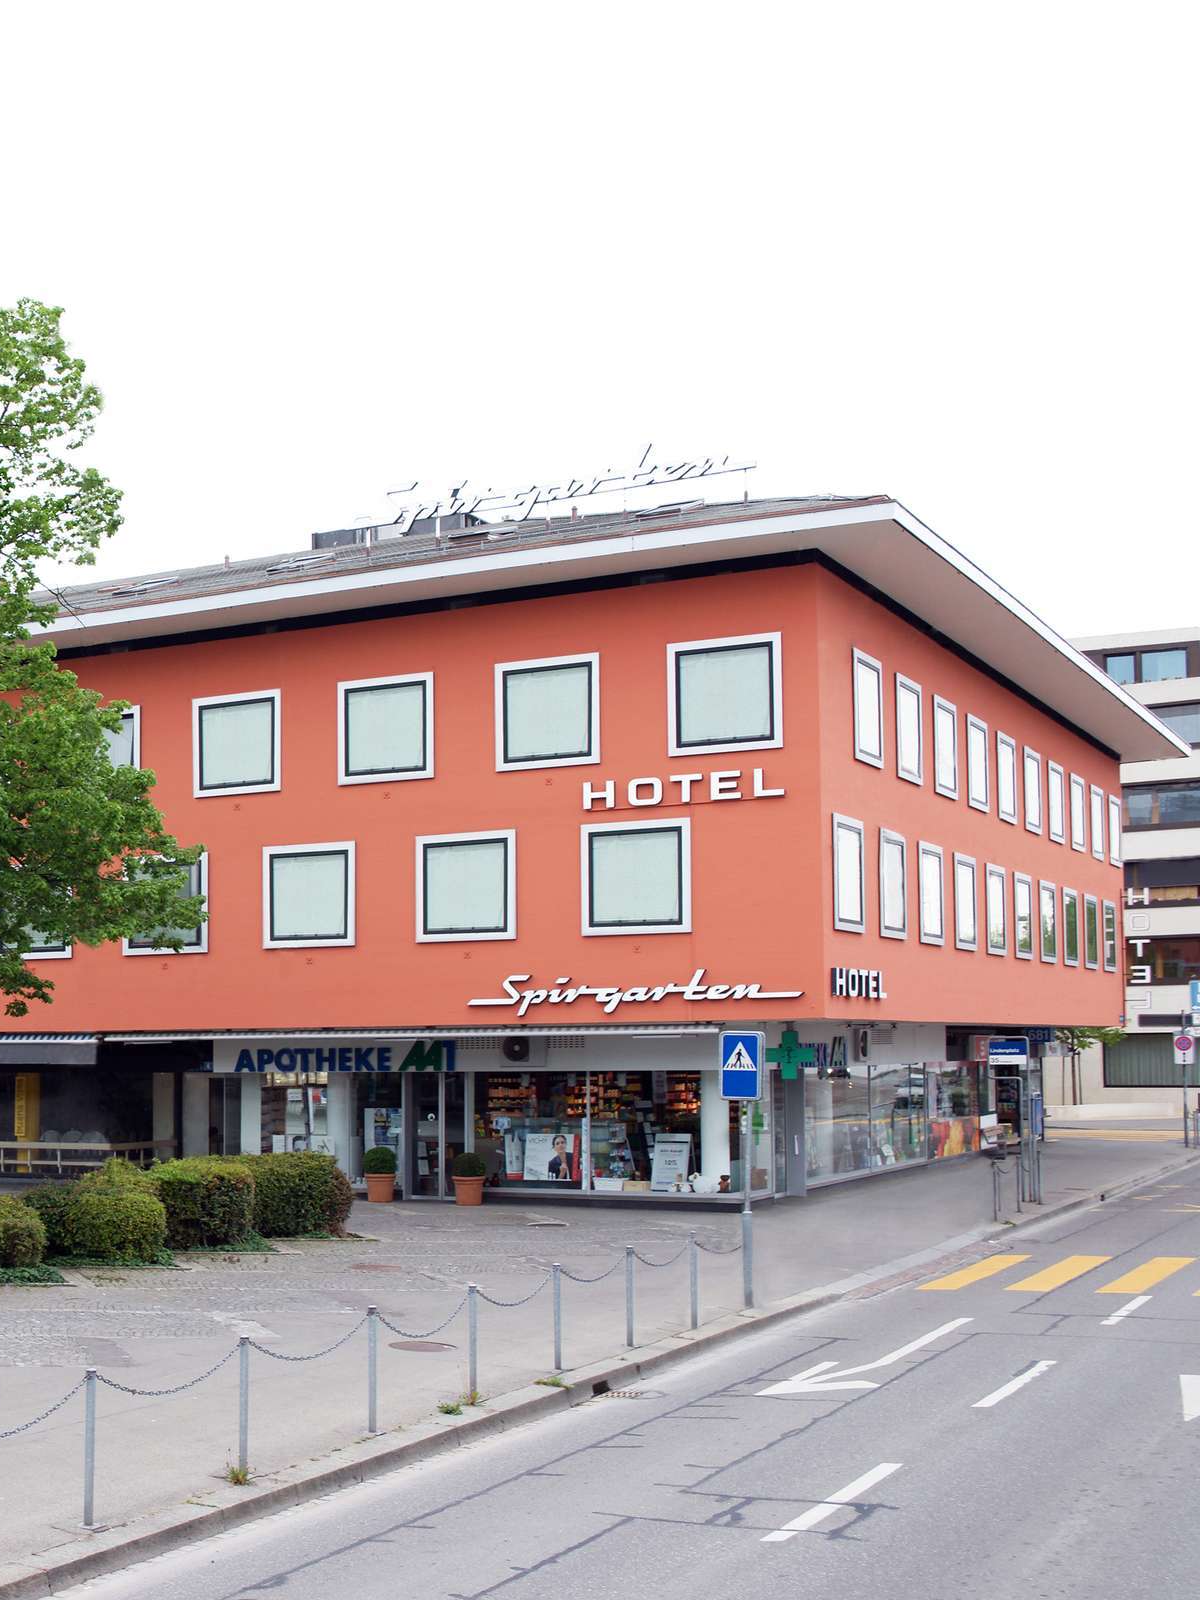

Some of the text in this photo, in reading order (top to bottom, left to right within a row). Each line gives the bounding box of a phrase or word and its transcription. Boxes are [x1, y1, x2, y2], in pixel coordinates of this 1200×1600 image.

[582, 767, 786, 811] HOTEL
[468, 969, 804, 1016] Spirgarten
[832, 967, 888, 999] HOTEL
[234, 1047, 392, 1072] APOTHEKE
